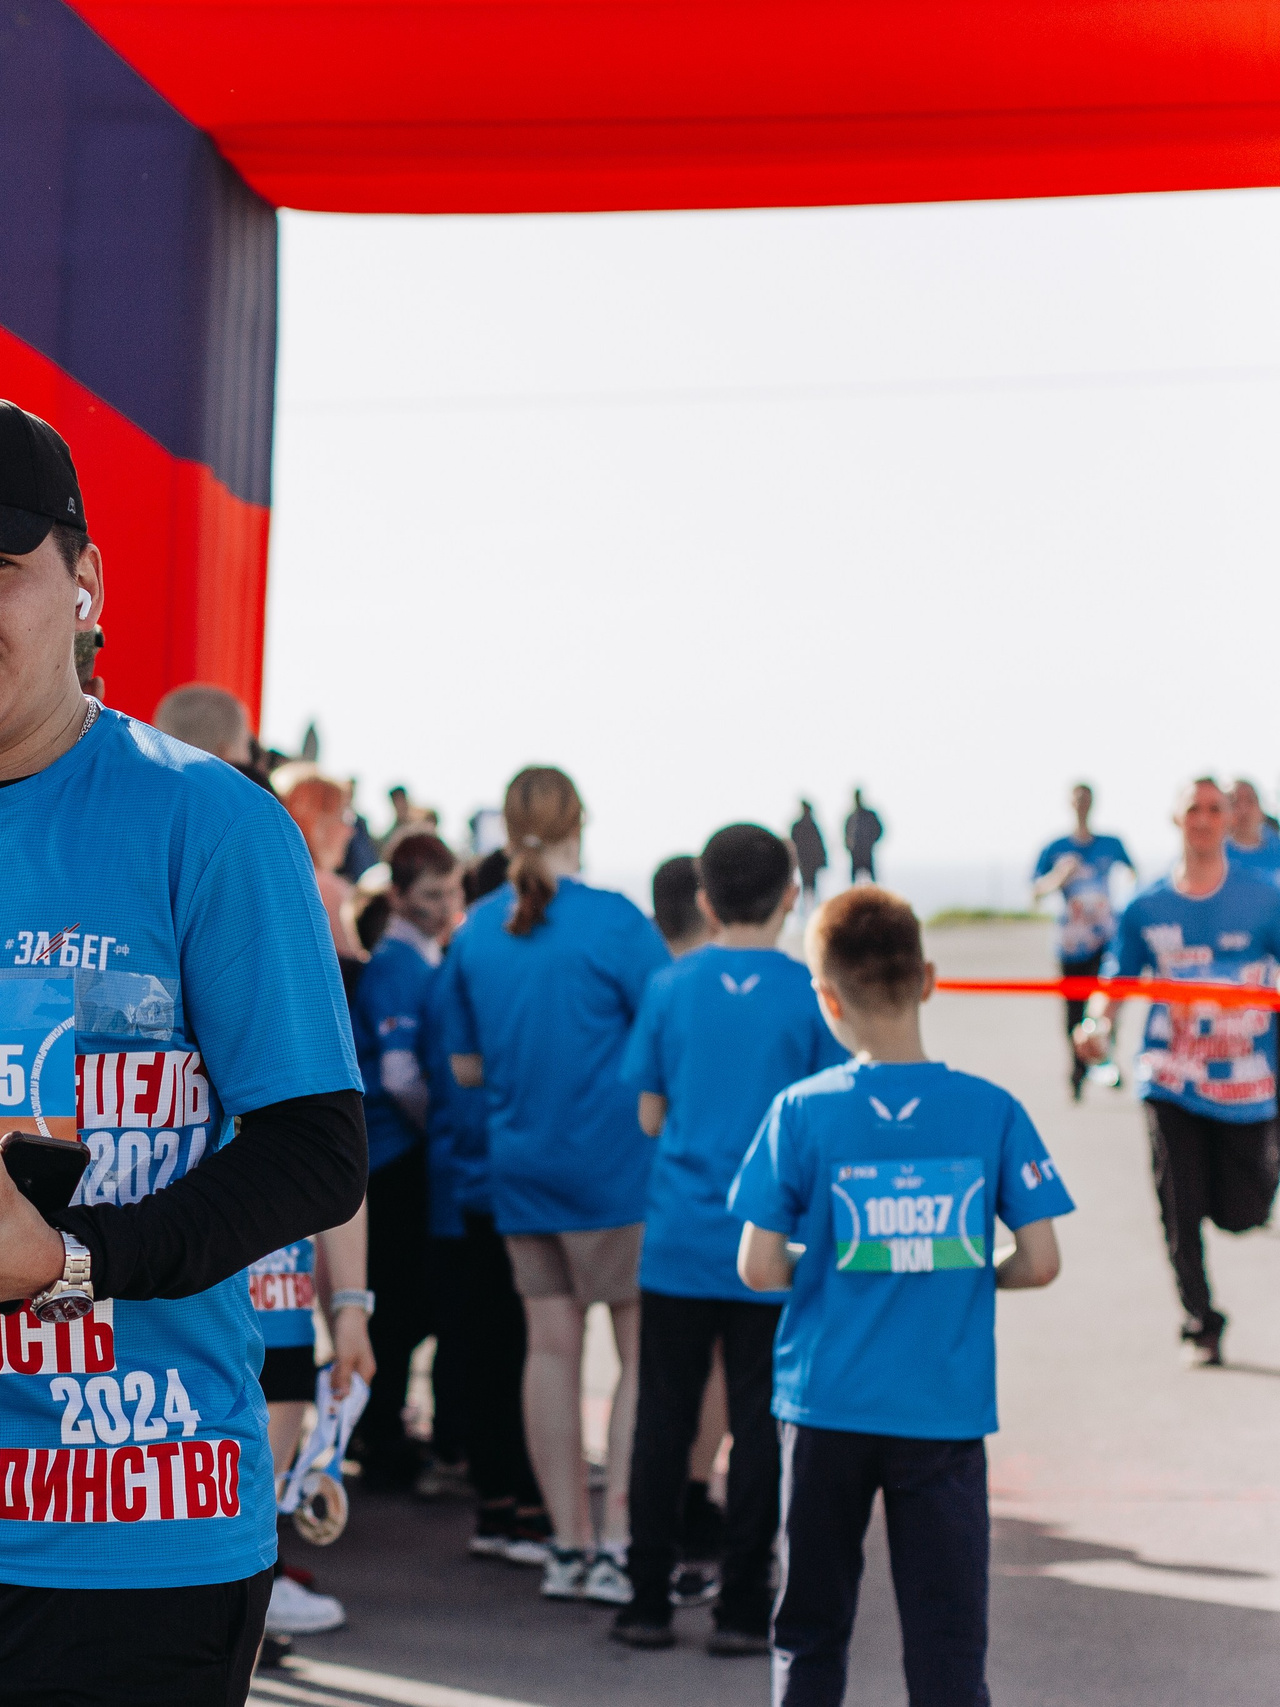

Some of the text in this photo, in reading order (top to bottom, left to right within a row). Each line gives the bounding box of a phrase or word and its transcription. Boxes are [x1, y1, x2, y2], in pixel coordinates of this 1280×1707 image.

[76, 1052, 211, 1128] ЦЕЛЬ
[865, 1195, 954, 1236] 10037
[49, 1368, 202, 1445] 2024
